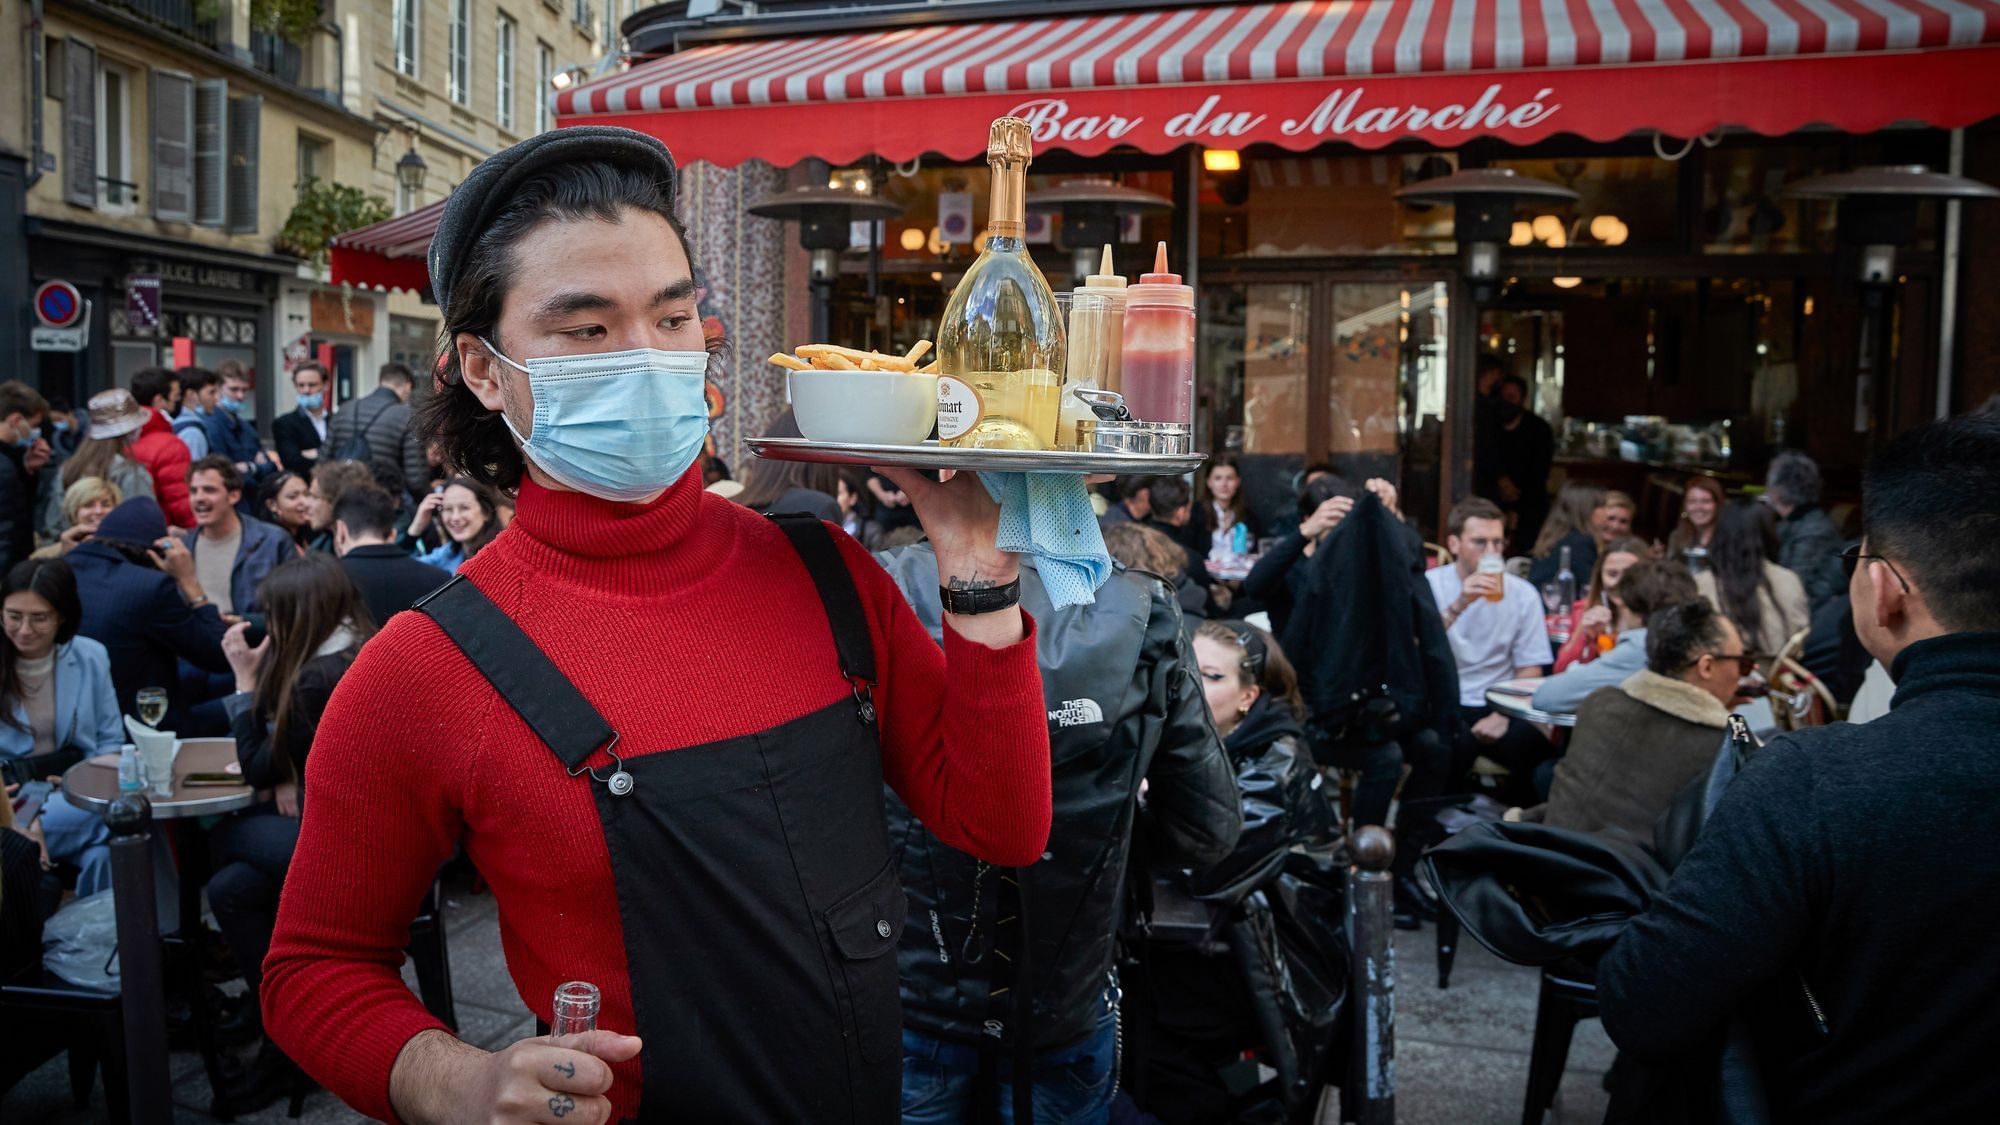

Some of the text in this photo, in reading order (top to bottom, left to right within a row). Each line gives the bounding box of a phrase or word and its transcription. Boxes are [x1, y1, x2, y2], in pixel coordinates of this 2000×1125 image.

[1007, 83, 1562, 142] Bar du Marché
[937, 399, 962, 413] uinart
[1062, 699, 1083, 709] THE
[1048, 707, 1083, 720] NORTH
[1059, 716, 1088, 727] FACE
